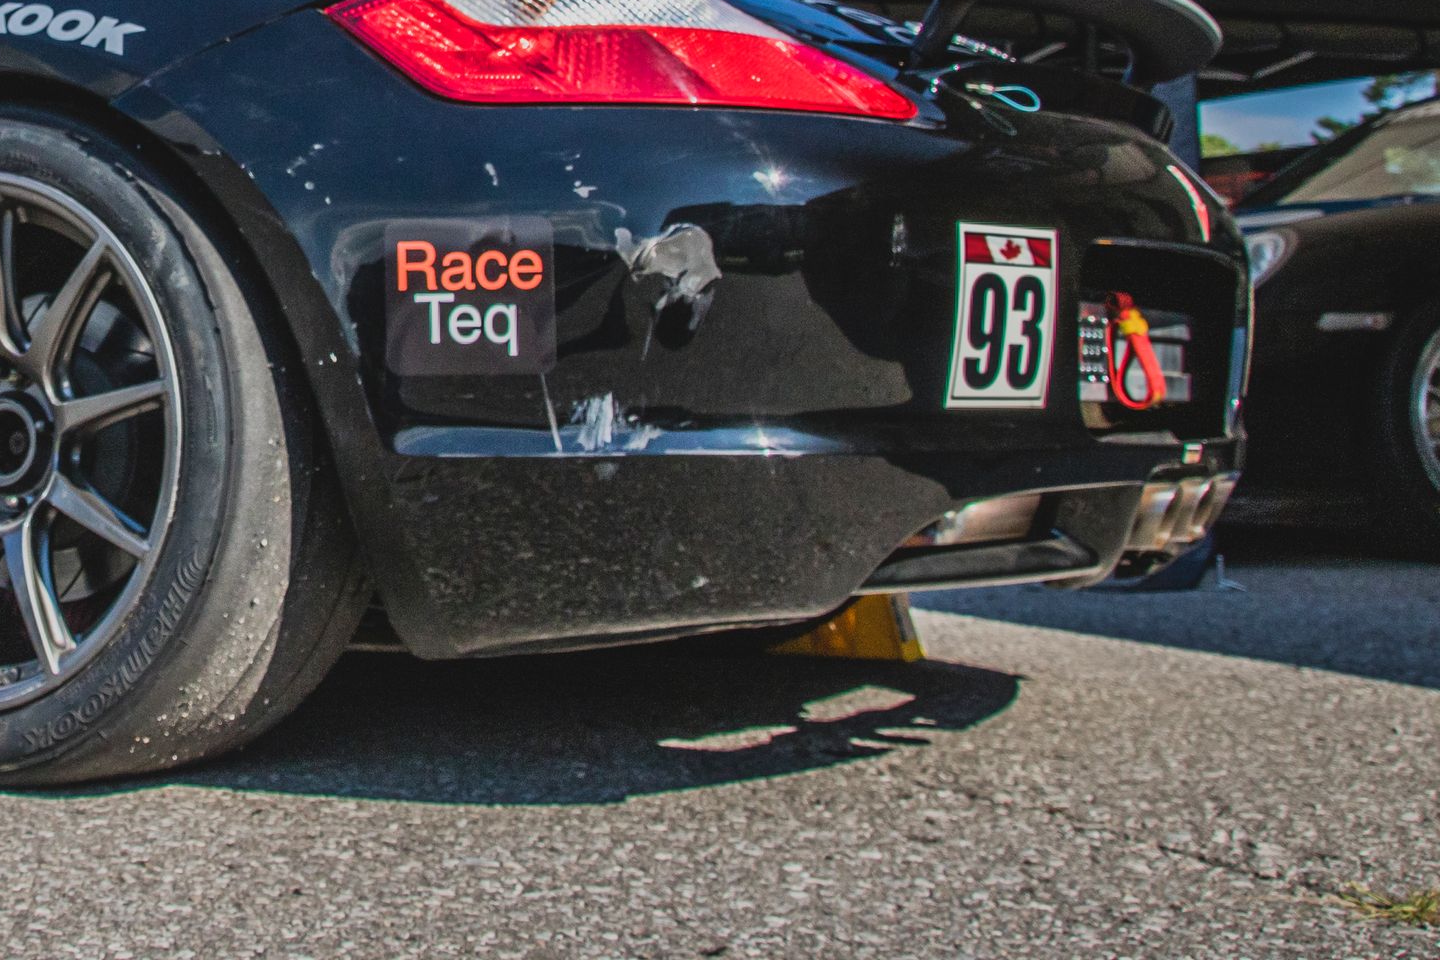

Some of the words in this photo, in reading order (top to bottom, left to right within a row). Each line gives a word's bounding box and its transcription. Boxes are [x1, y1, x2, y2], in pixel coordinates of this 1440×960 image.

[397, 240, 544, 292] Race
[414, 292, 519, 357] Teq
[962, 272, 1046, 391] 93
